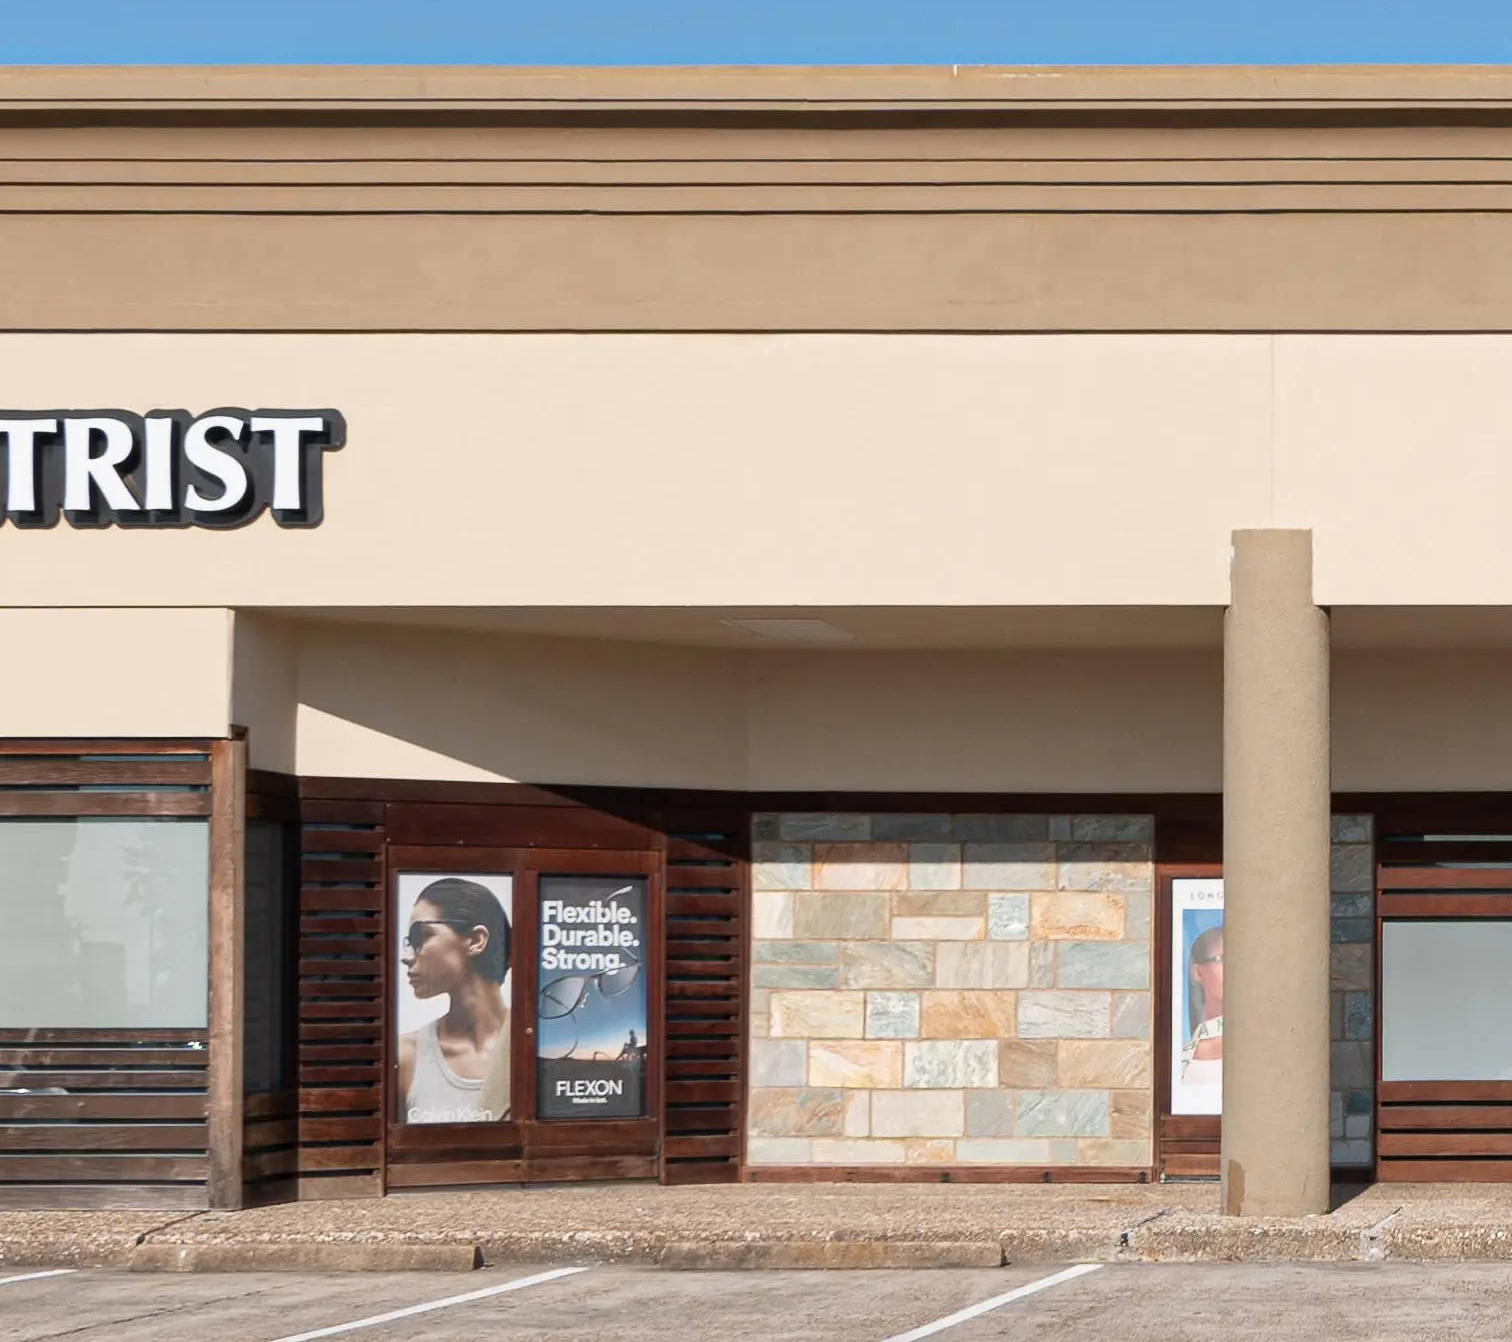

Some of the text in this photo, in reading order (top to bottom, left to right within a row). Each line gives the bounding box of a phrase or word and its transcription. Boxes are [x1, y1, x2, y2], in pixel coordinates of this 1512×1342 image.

[542, 899, 638, 924] Flexible.
[542, 924, 640, 947] Durable.
[542, 946, 627, 975] Strong.
[556, 1079, 623, 1097] FLEXON
[458, 1105, 492, 1122] Klein
